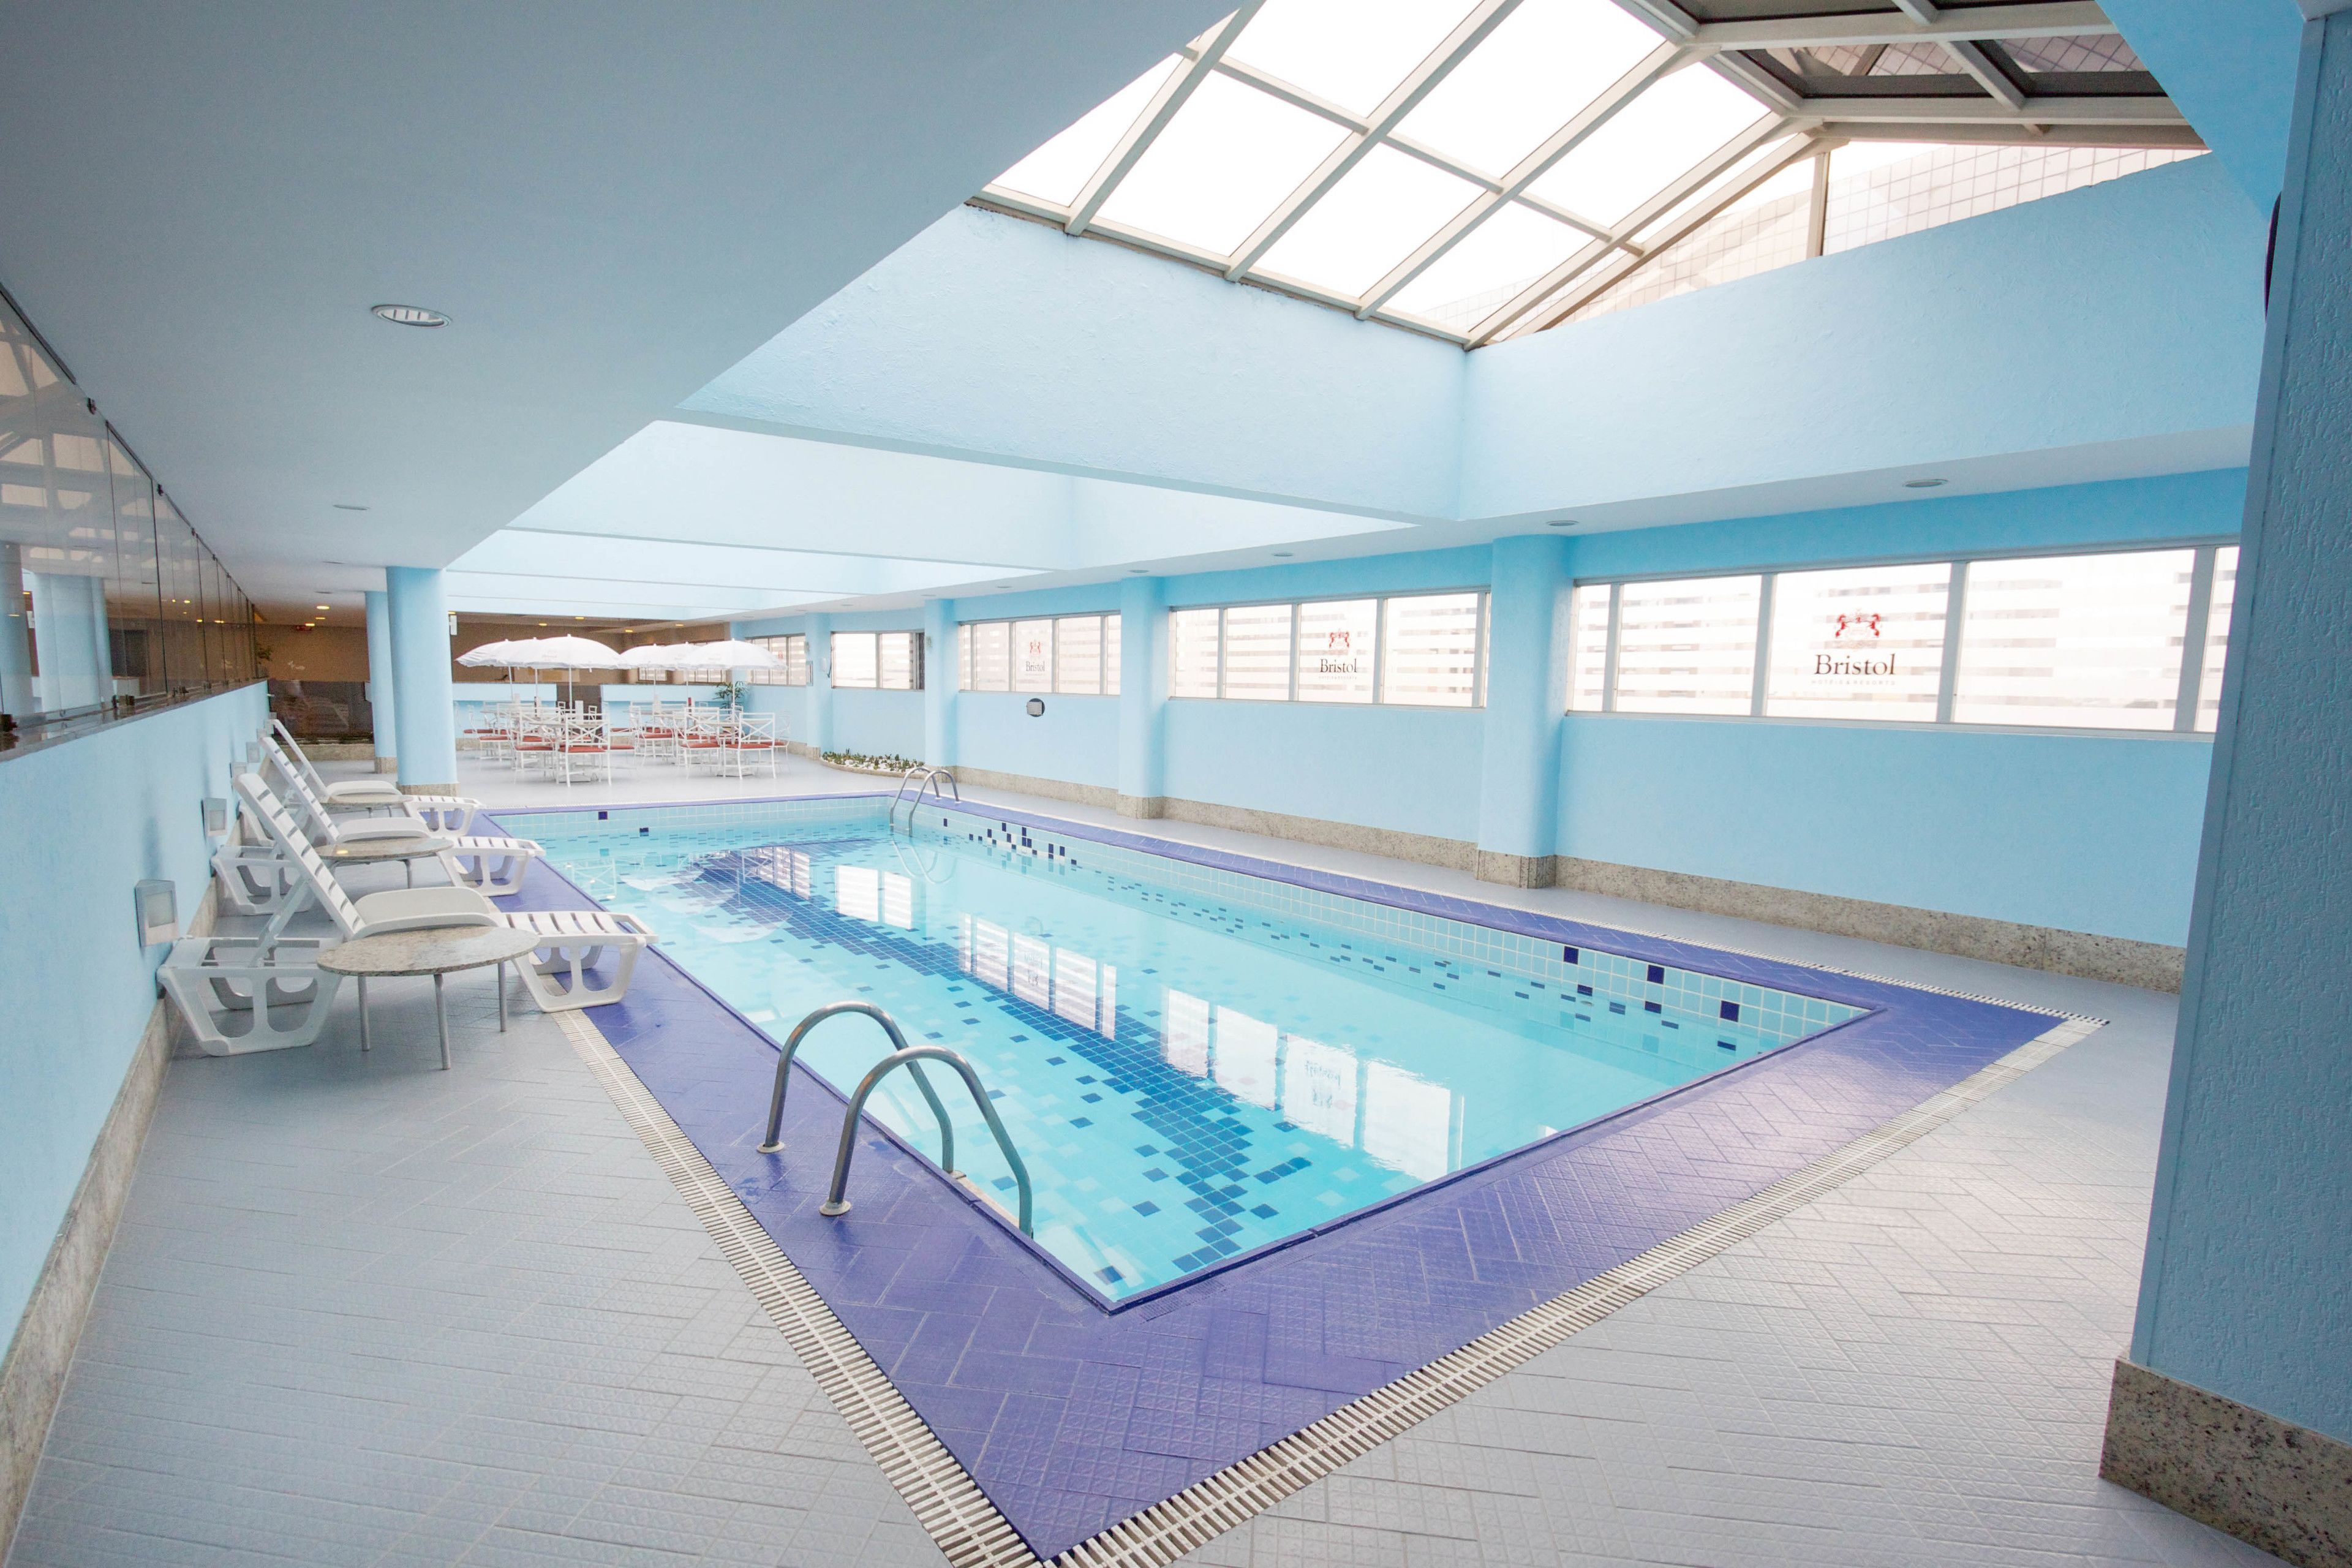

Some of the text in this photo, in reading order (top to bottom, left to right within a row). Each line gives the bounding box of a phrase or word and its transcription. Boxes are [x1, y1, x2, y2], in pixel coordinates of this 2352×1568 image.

[1025, 661, 1045, 672] Bristol
[1319, 658, 1357, 673] Bristol
[1814, 653, 1896, 676] Bristol
